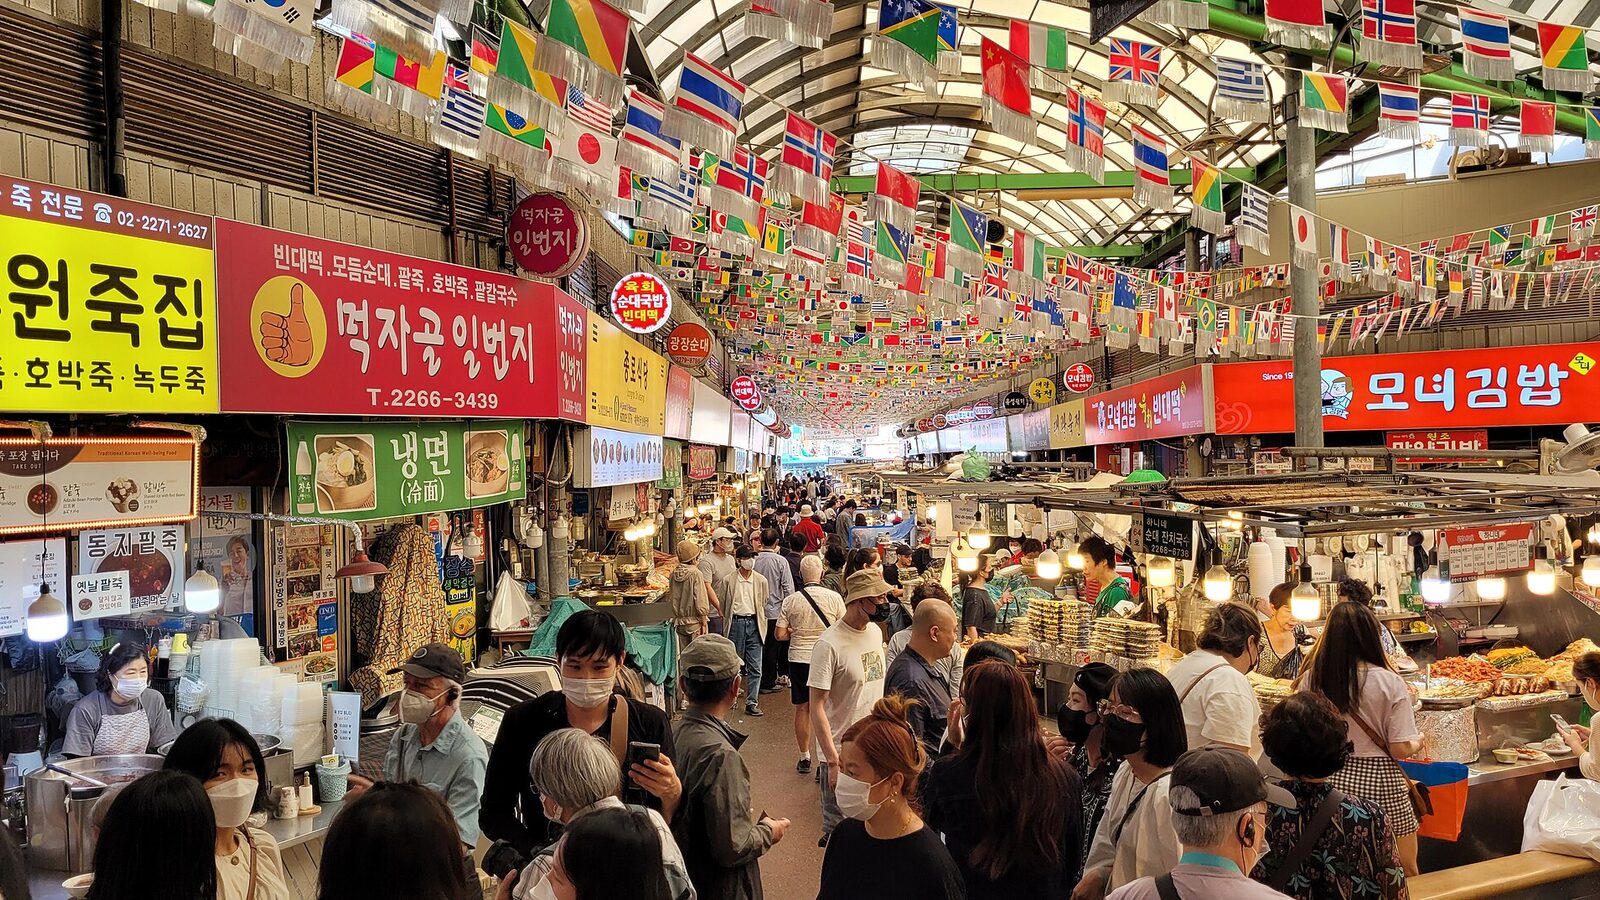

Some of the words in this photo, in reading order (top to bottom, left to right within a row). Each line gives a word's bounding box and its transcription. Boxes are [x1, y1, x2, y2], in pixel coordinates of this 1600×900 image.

[10, 184, 33, 212] 죽
[40, 190, 84, 220] 전문
[117, 210, 208, 240] 02-2271-2627
[520, 206, 565, 225] 먹자골
[513, 228, 572, 256] 일번지
[616, 293, 665, 309] 순대국밥
[622, 308, 659, 322] 빈대떡
[558, 303, 583, 353] 먹자골
[336, 297, 445, 377] 먹자골
[452, 314, 535, 385] 일번지
[670, 336, 709, 353] 광장순대
[560, 350, 583, 396] 일번지
[623, 349, 649, 391] 종로식당
[1262, 373, 1283, 381] Since
[1284, 371, 1294, 380] 19
[366, 387, 498, 410] T.2266-3439
[1365, 363, 1570, 412] 모녀김밥
[1107, 397, 1137, 432] 모녀김밥
[1153, 387, 1181, 425] 빈대떡
[1426, 432, 1450, 441] 원조
[8, 449, 28, 461] 포장
[31, 449, 60, 461] 됩니다
[389, 430, 451, 479] 냉면
[400, 476, 445, 507] (冷面)
[1146, 518, 1167, 528] 하니네
[87, 529, 177, 558] 동지팥죽
[1145, 530, 1160, 543] 순대
[1161, 531, 1191, 548] 잔치국수
[1151, 544, 1190, 558] 2268-6738
[77, 580, 98, 594] 옛날
[100, 577, 122, 591] 팥죽
